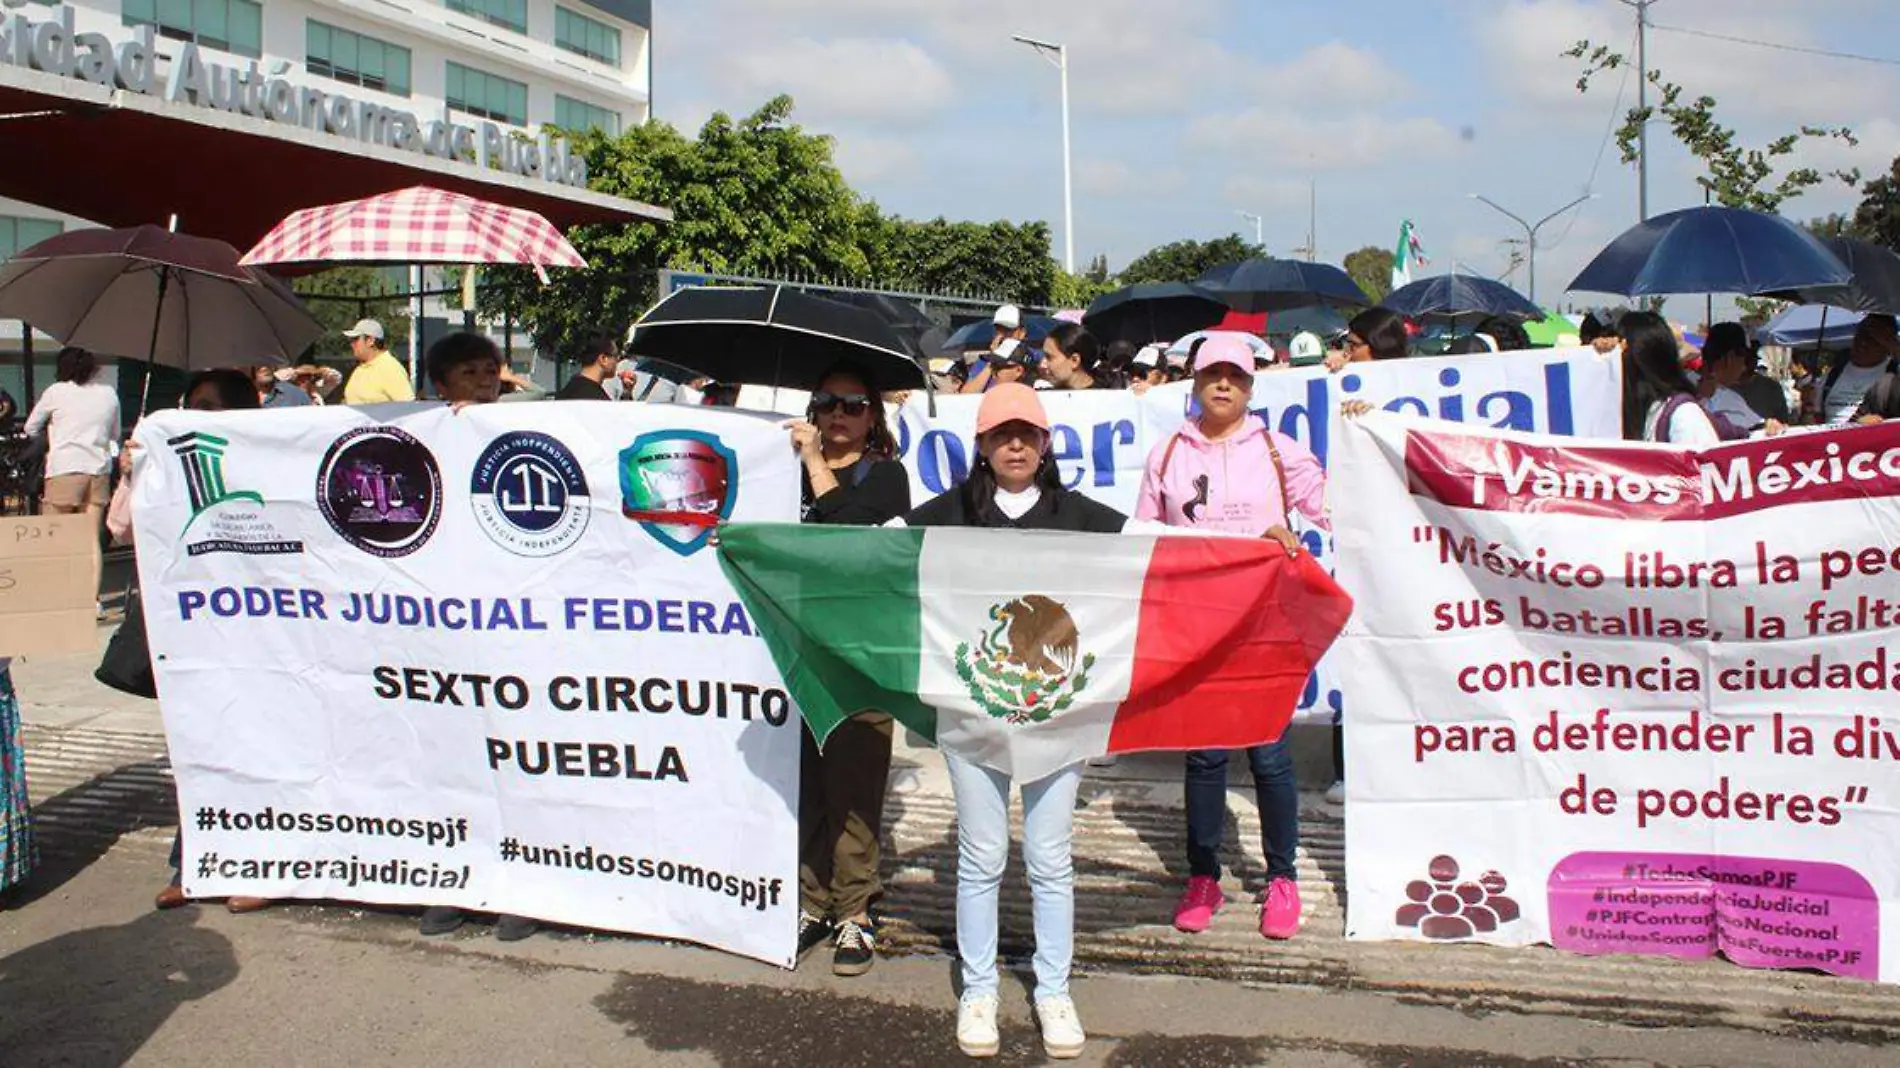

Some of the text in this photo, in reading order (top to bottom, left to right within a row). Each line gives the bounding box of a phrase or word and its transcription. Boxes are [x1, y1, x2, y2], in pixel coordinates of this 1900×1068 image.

[165, 41, 423, 152] Autónoma
[424, 101, 477, 164] de
[477, 121, 588, 188] Puebla
[480, 444, 510, 484] JUSTICIA
[1413, 526, 1604, 588] "México
[1625, 551, 1738, 588] libra
[1756, 542, 1798, 585] la
[178, 586, 761, 637] PODER JUDICIAL FEDERA
[1434, 598, 1504, 632] sus
[1522, 597, 1723, 642] batallas,
[1744, 606, 1786, 639] la
[1457, 651, 1701, 694] conciencia
[372, 666, 789, 727] SEXTO CIRCUITO
[1414, 724, 1516, 762] para
[1532, 708, 1755, 752] defender
[1774, 712, 1814, 756] la
[486, 737, 689, 783] PUEBLA
[1559, 773, 1618, 815] de
[196, 806, 467, 847] #todossomospjf
[198, 852, 470, 889] #carrerajudicial
[500, 837, 782, 911] #unidossomospjf
[1622, 863, 1797, 890] #TodosSomosPJF
